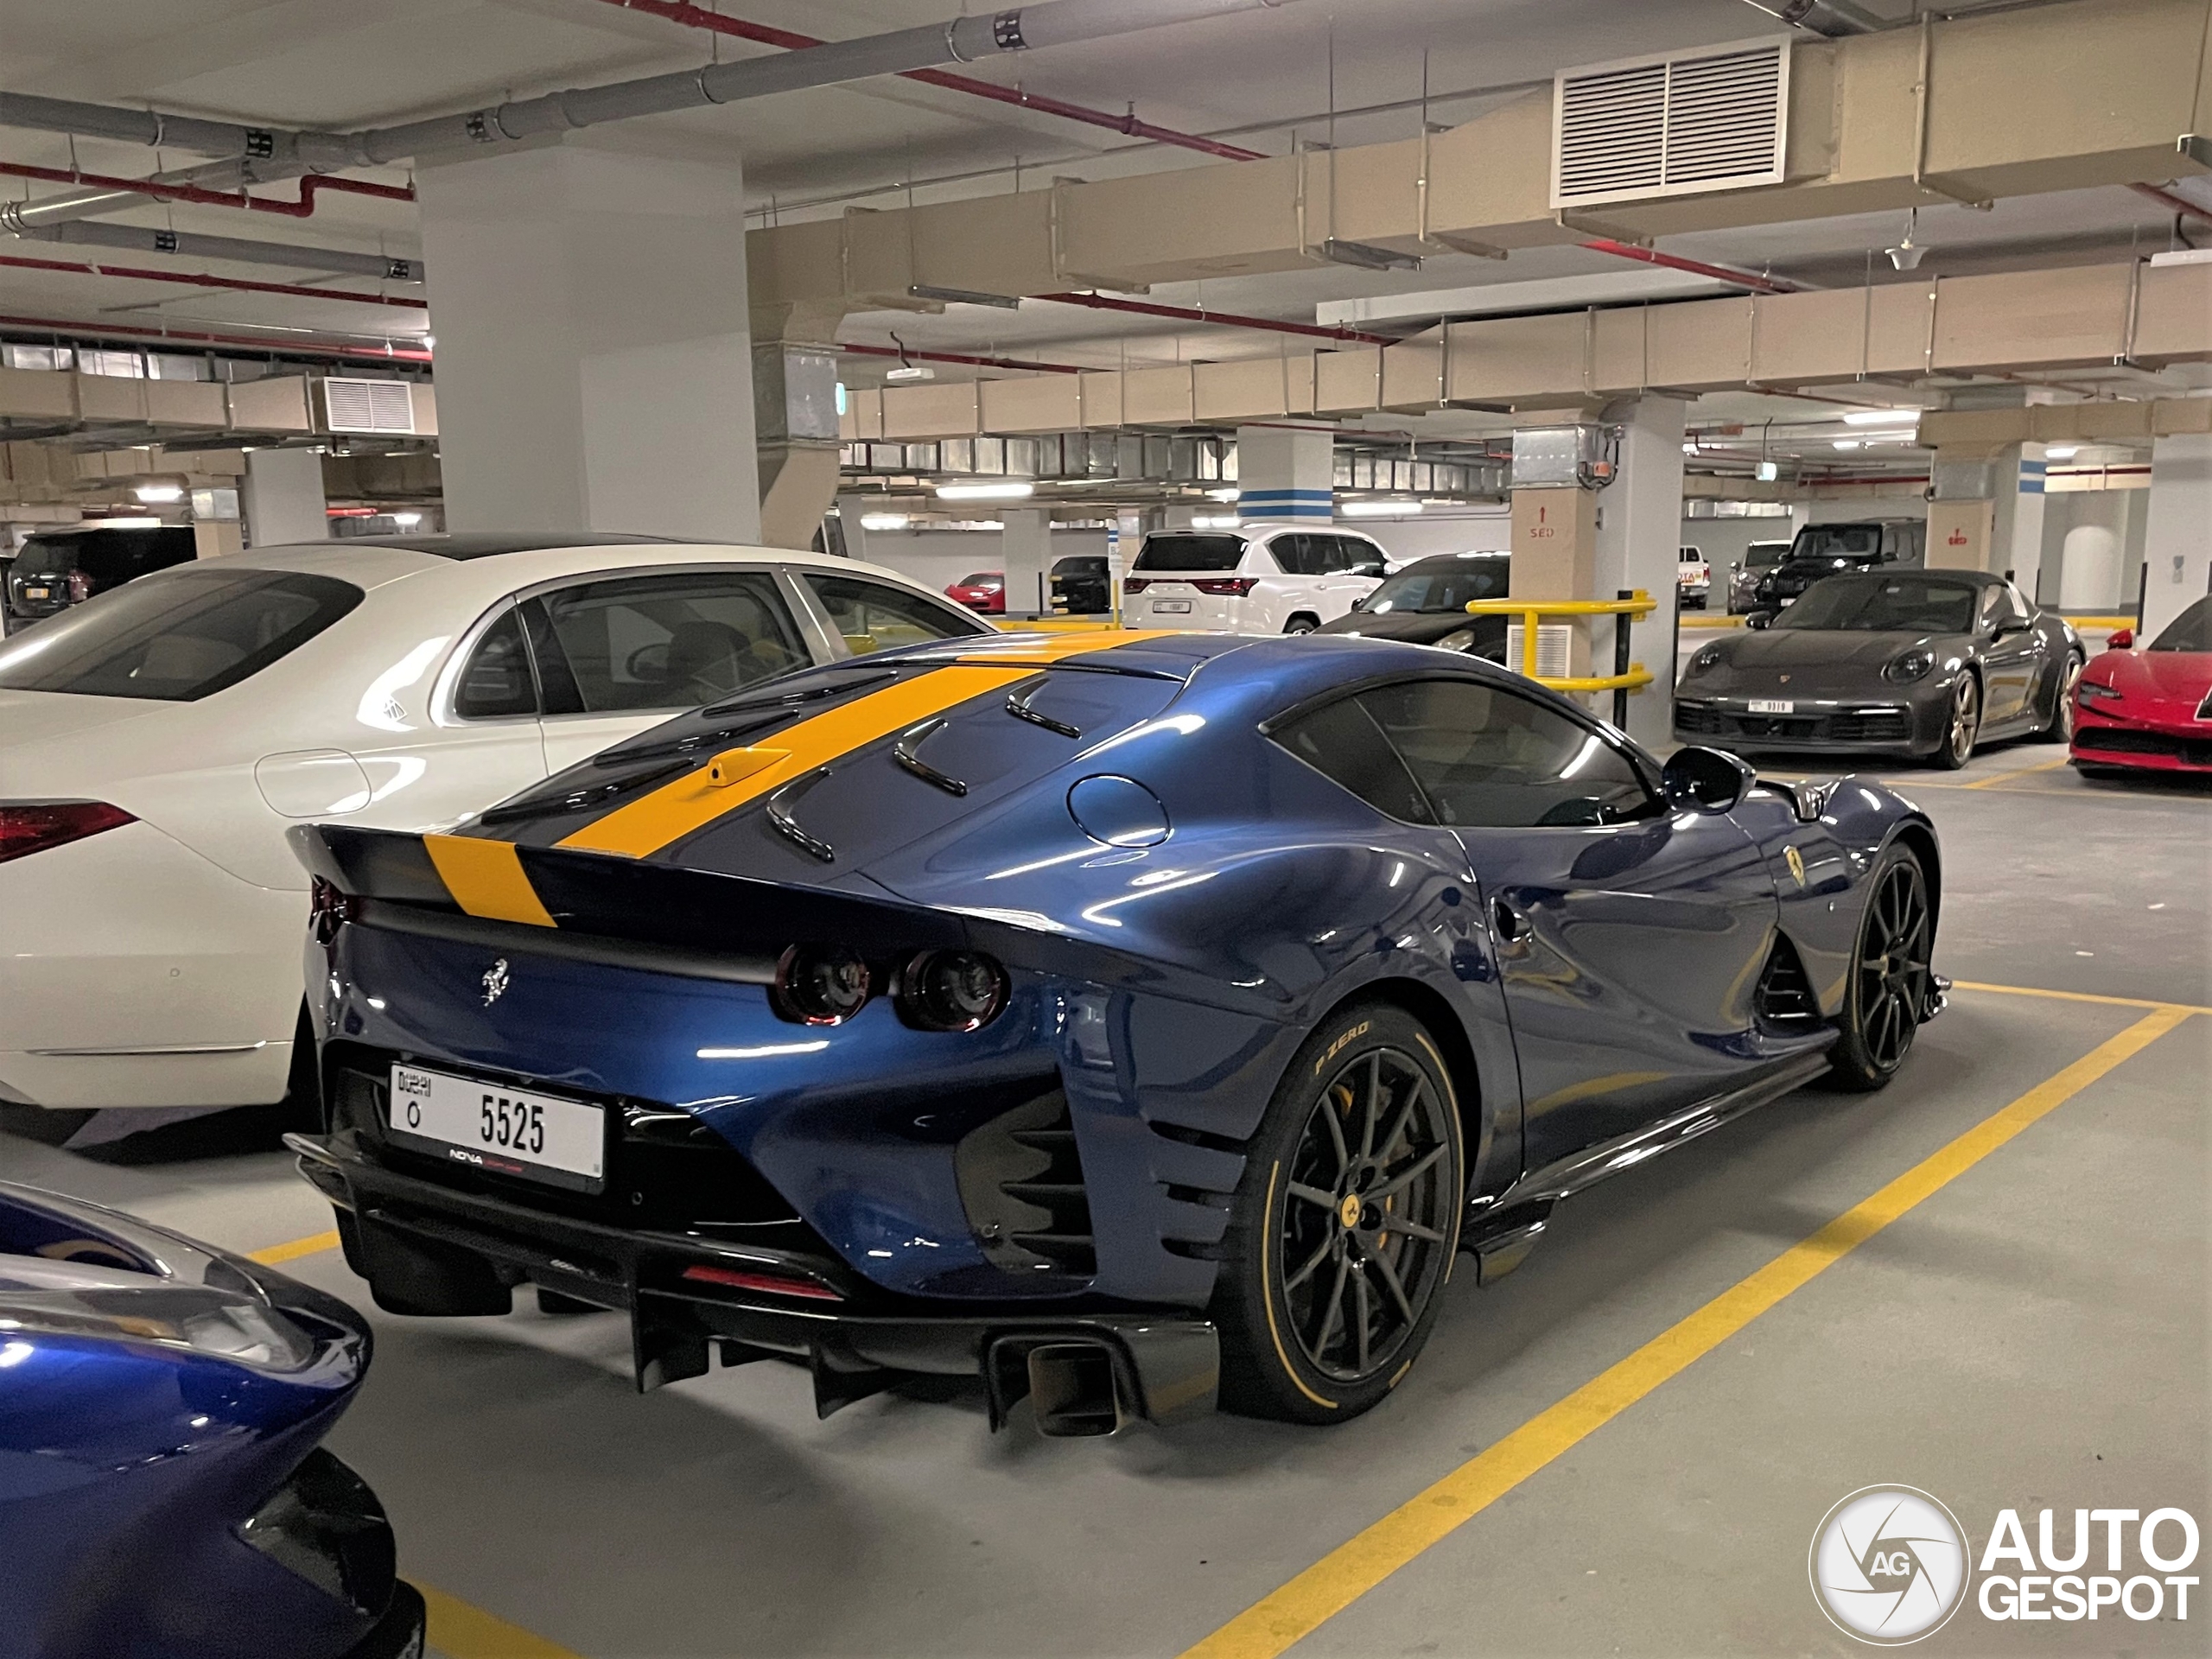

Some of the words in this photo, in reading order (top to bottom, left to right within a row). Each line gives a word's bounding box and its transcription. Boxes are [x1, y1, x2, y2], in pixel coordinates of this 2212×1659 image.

[1530, 528, 1554, 537] SED
[1315, 1055, 1325, 1076] P
[1327, 1020, 1370, 1060] ZERO
[481, 1094, 543, 1154] 5525
[449, 1149, 483, 1165] NOVA
